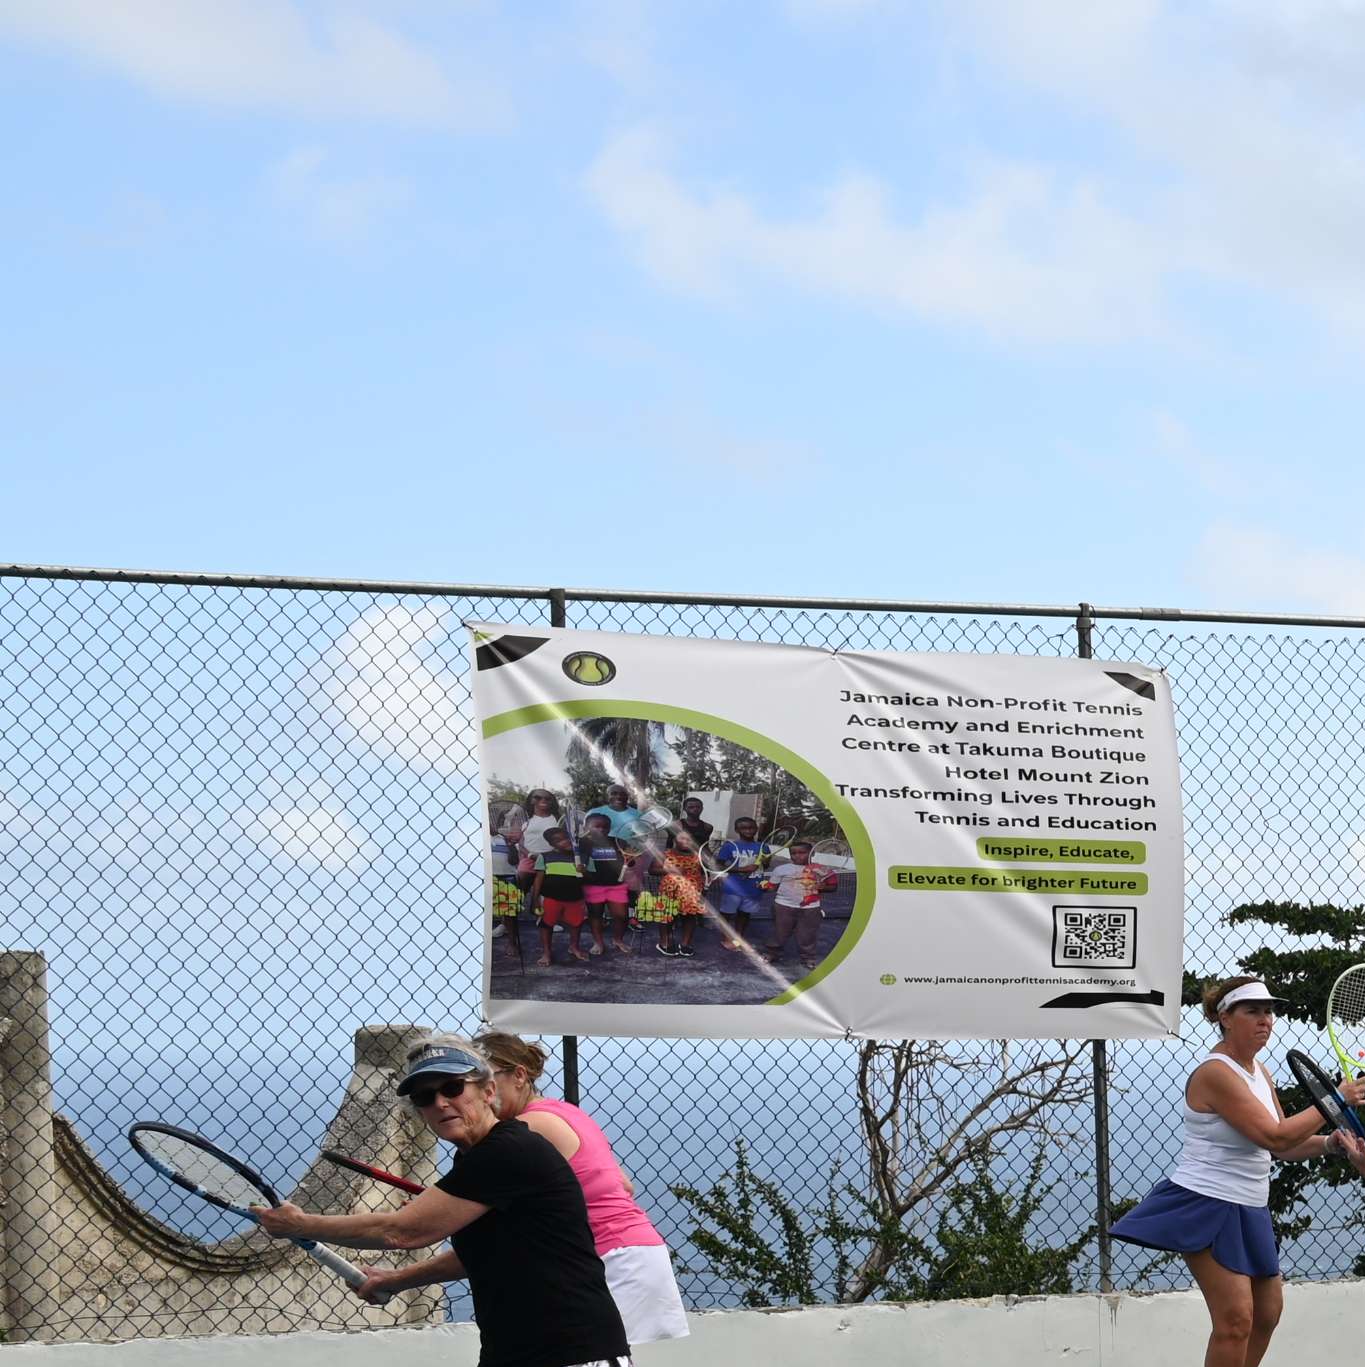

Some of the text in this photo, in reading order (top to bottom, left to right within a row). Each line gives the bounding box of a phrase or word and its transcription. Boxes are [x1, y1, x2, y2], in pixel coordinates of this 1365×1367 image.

[839, 690, 1143, 716] Jamaica Non-Profit Tennis
[845, 714, 1145, 740] Academy and Enrichment
[841, 737, 1146, 764] Centre at Takuma Boutique
[945, 766, 1149, 786] Hotel Mount Zion
[834, 783, 1156, 811] Transforming Lives Through
[914, 811, 1157, 832] Tennis and Education
[984, 843, 1135, 861] Inspire, Educate,
[897, 872, 1137, 891] Elevate for brighter Future
[903, 975, 1136, 988] www.jamaicanonprofittennisacademy.org
